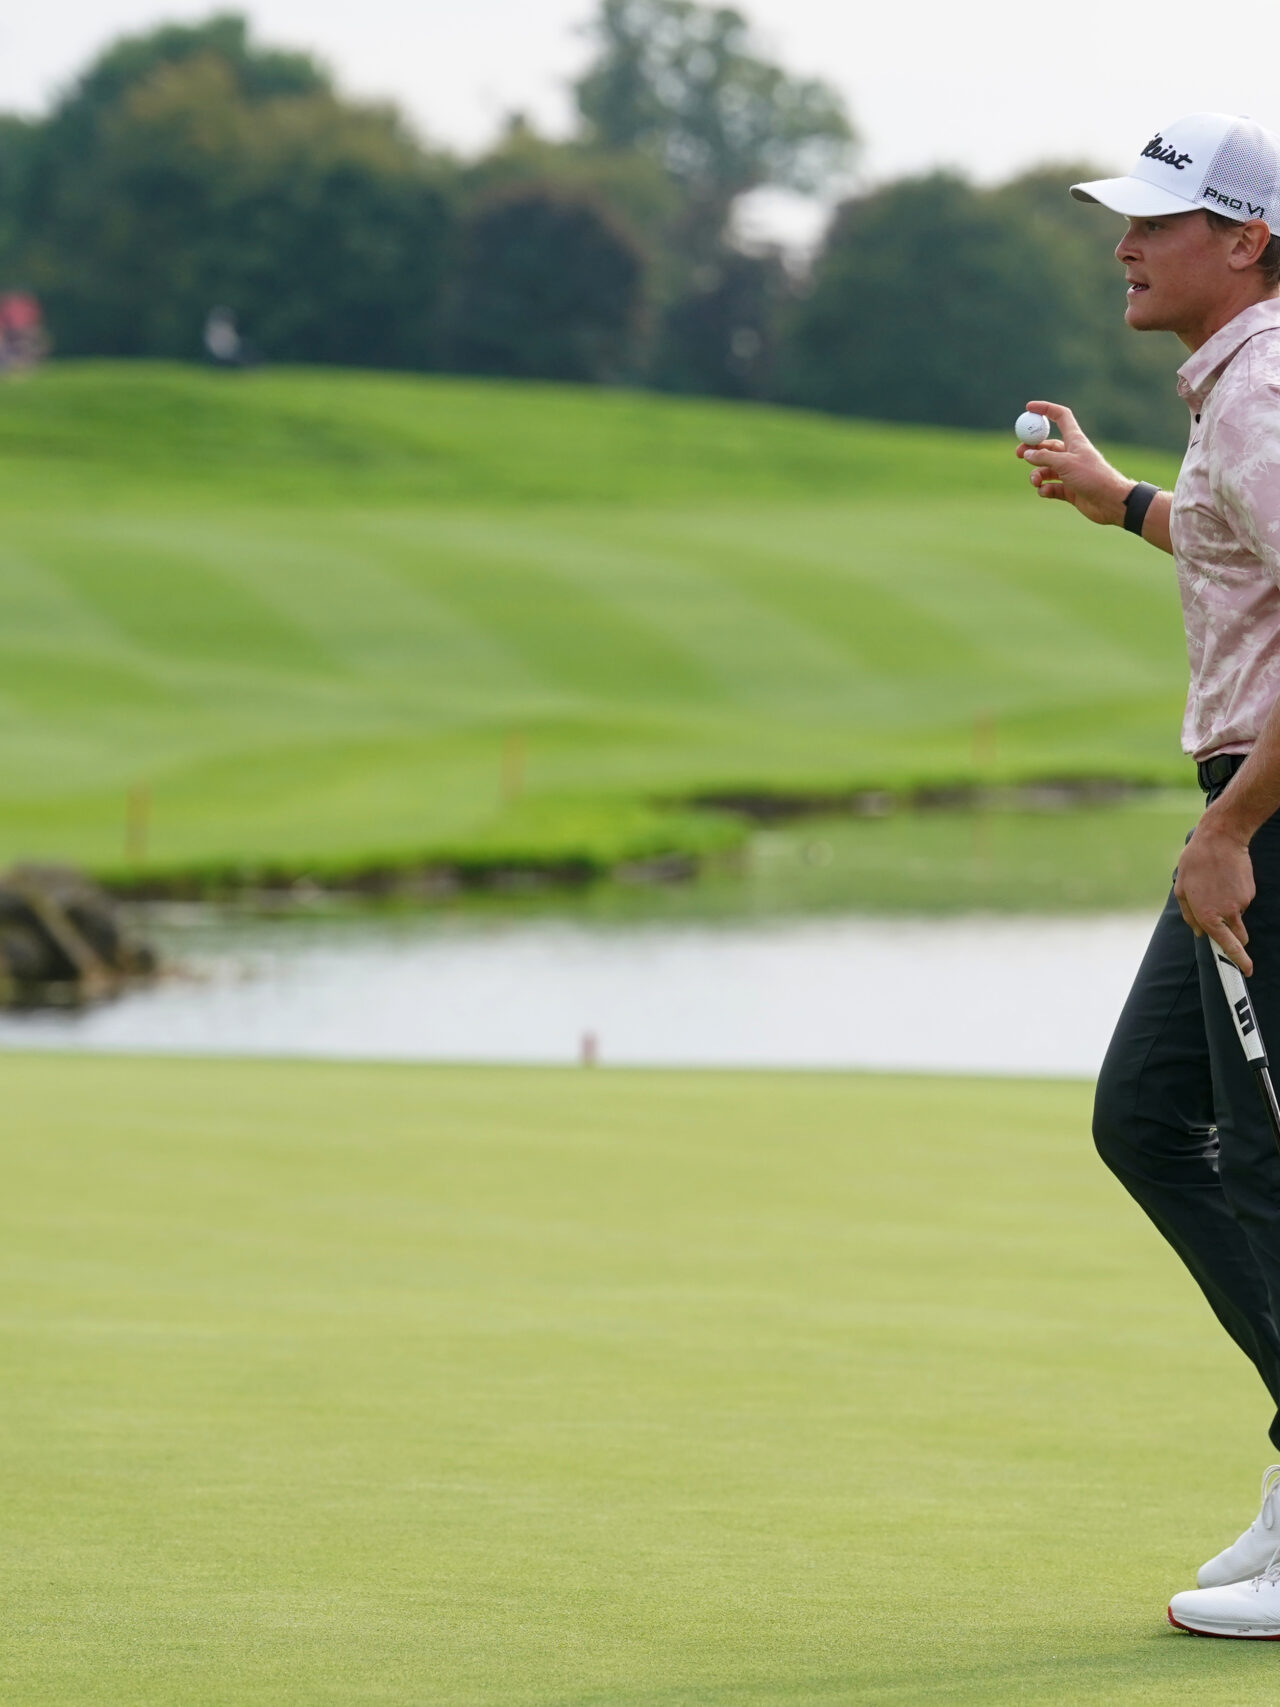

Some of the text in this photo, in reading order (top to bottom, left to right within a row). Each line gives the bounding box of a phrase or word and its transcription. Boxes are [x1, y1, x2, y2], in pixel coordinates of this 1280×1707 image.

[1140, 132, 1193, 170] leist
[1202, 186, 1265, 219] PRO V1
